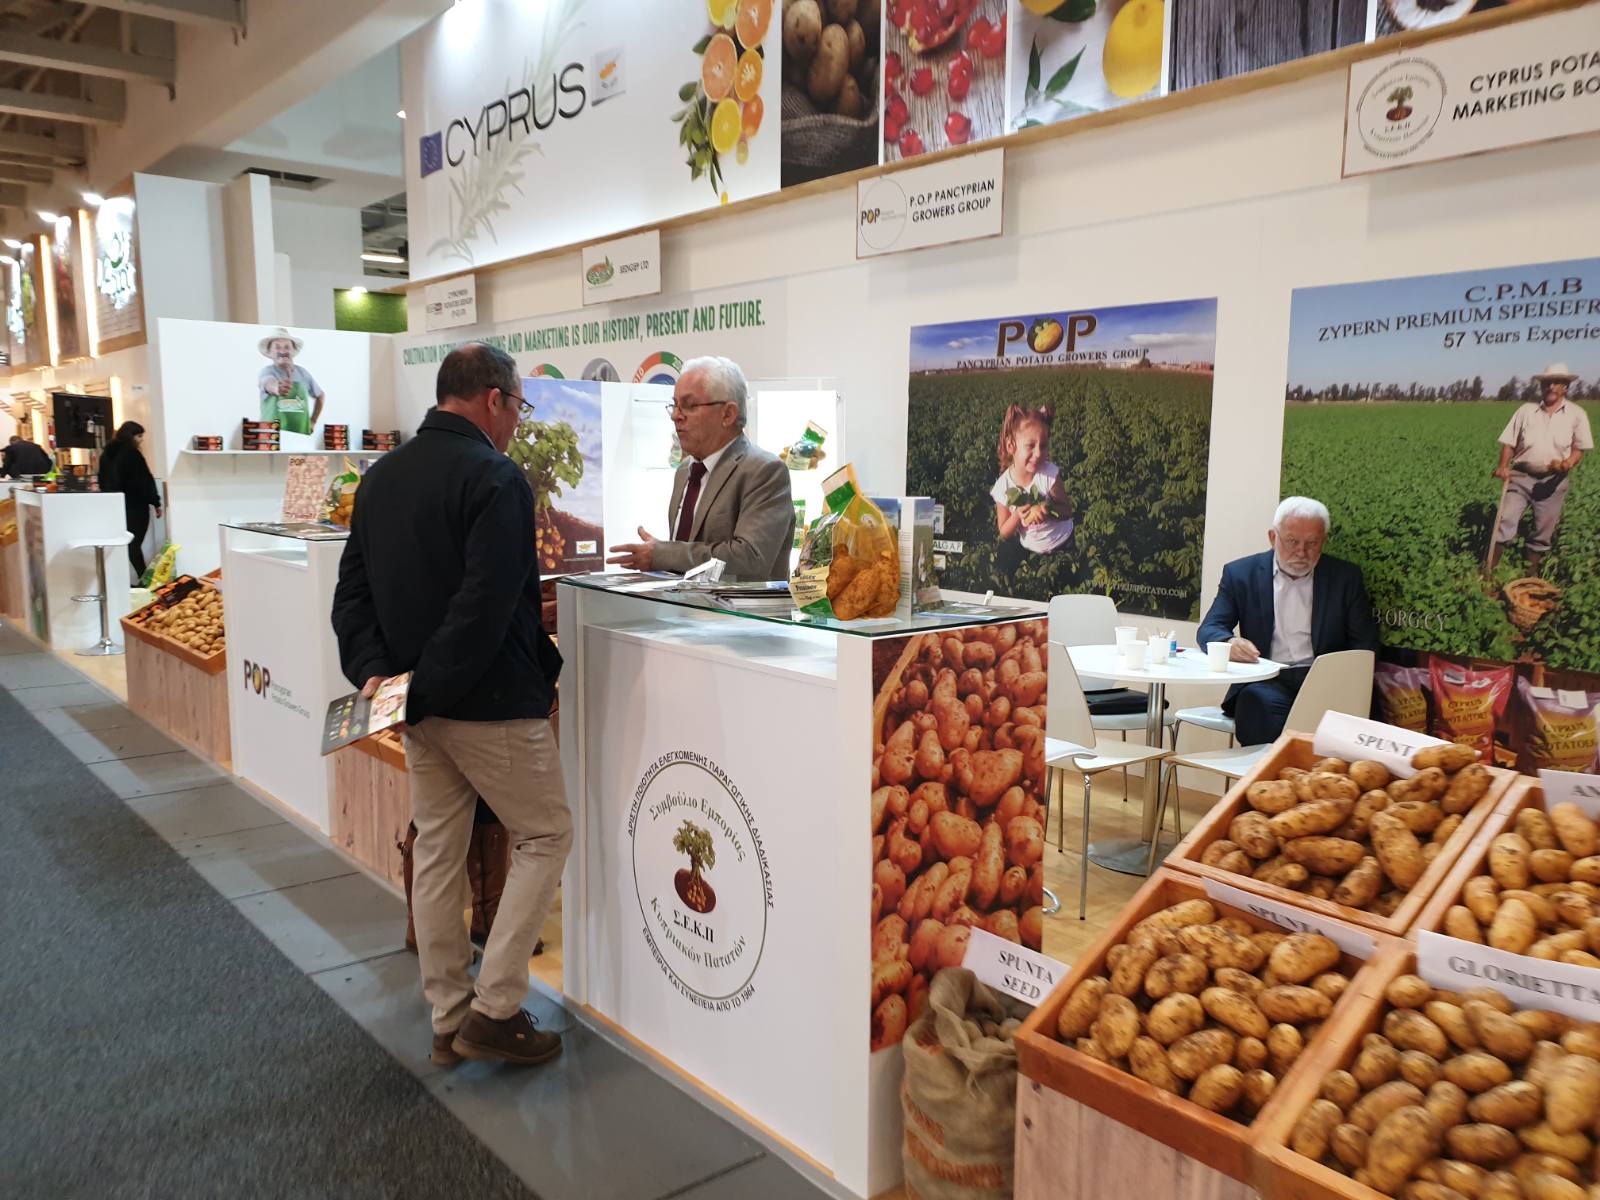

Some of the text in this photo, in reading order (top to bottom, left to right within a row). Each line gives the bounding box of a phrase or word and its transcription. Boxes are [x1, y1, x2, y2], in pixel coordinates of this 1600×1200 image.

[1470, 62, 1543, 94] CYPRUS
[445, 62, 587, 167] CYPRUS
[1452, 83, 1566, 121] MARKETING
[935, 179, 995, 202] PANCYPRIAN
[861, 208, 880, 226] POP
[912, 204, 955, 223] GROWERS
[958, 197, 991, 214] GROUP
[1465, 277, 1583, 303] C.P.M.B
[507, 332, 522, 354] AND
[524, 325, 569, 352] MARKETING
[572, 324, 580, 346] IS
[583, 321, 600, 345] OUR
[602, 315, 643, 343] HISTORY,
[646, 308, 690, 339] PRESENT
[693, 305, 716, 333] AND
[719, 299, 766, 330] FUTURE.
[1318, 298, 1600, 342] ZYPERN PREMIUM SPEISEFR
[996, 314, 1097, 357] POP
[1444, 322, 1600, 349] 57 Years Experie
[956, 348, 1150, 369] PANCYPRIAN POTATO GROWERS GROUP
[1372, 607, 1449, 631] B.ORG.CY
[243, 659, 271, 699] POP
[1354, 732, 1415, 757] SPUNT
[998, 950, 1054, 984] SPUNTA
[741, 983, 756, 1002] 1964
[1001, 973, 1041, 999] SEED
